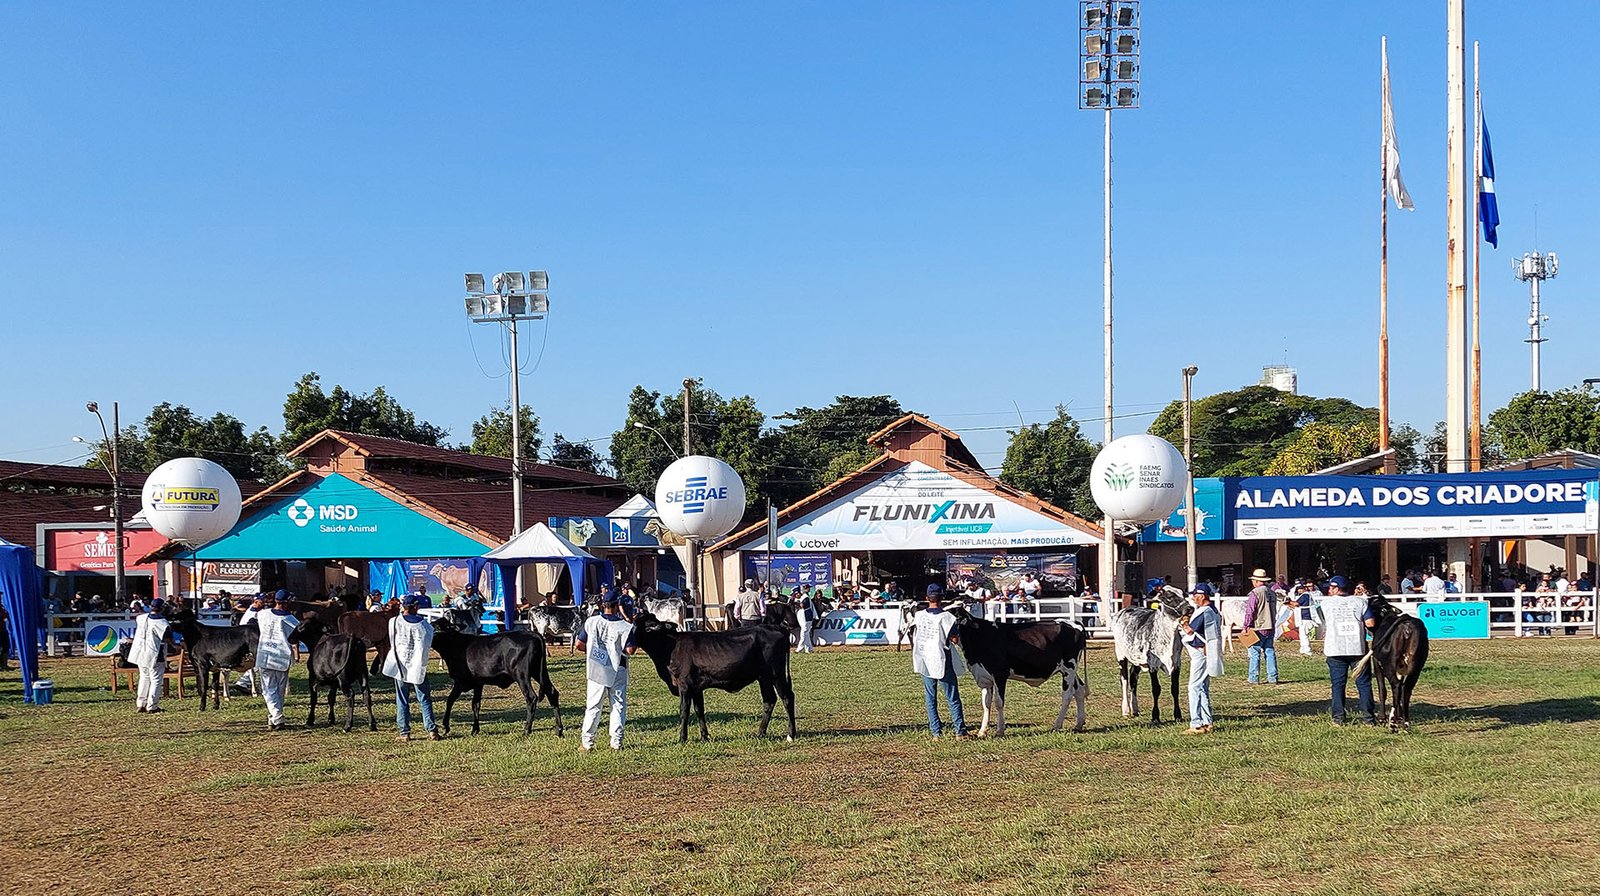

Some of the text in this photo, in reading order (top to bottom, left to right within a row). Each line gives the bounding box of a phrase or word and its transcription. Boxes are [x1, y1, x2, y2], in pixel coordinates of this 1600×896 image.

[167, 491, 217, 501] FUTURA
[665, 487, 728, 504] SEBRAE
[1234, 487, 1366, 509] ALAMEDA
[1372, 486, 1430, 506] DOS
[319, 504, 358, 520] MSD
[852, 500, 996, 523] FLUNIXINA
[319, 524, 378, 533] Saúde Animal
[799, 538, 840, 549] ucbvet
[959, 537, 1009, 547] INFLAMAÇÃO,
[1031, 537, 1075, 545] PRODUÇÃO!
[84, 543, 118, 558] SEME
[1439, 607, 1482, 617] alvoar
[812, 615, 887, 632] UNIXINA
